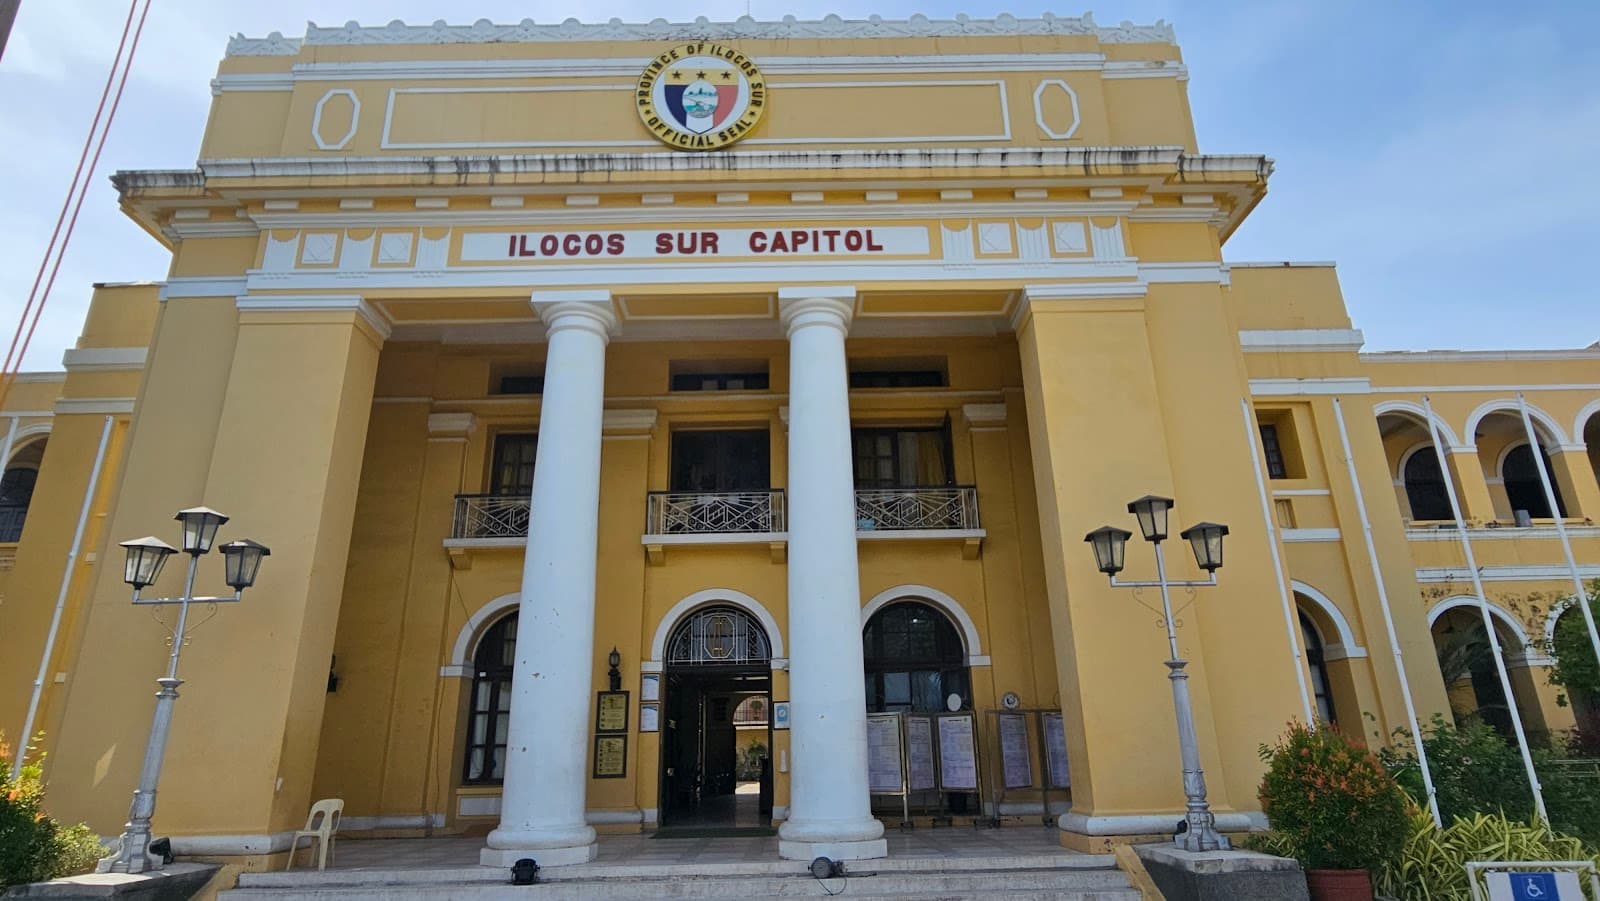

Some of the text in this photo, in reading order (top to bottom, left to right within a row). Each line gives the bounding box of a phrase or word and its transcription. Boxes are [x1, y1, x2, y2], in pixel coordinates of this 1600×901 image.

[638, 44, 763, 108] PROVINCE OF ILOCOS SUR
[648, 116, 752, 148] OFFICIAL SEAL
[508, 229, 884, 257] ILOCOS SUR CAPITOL
